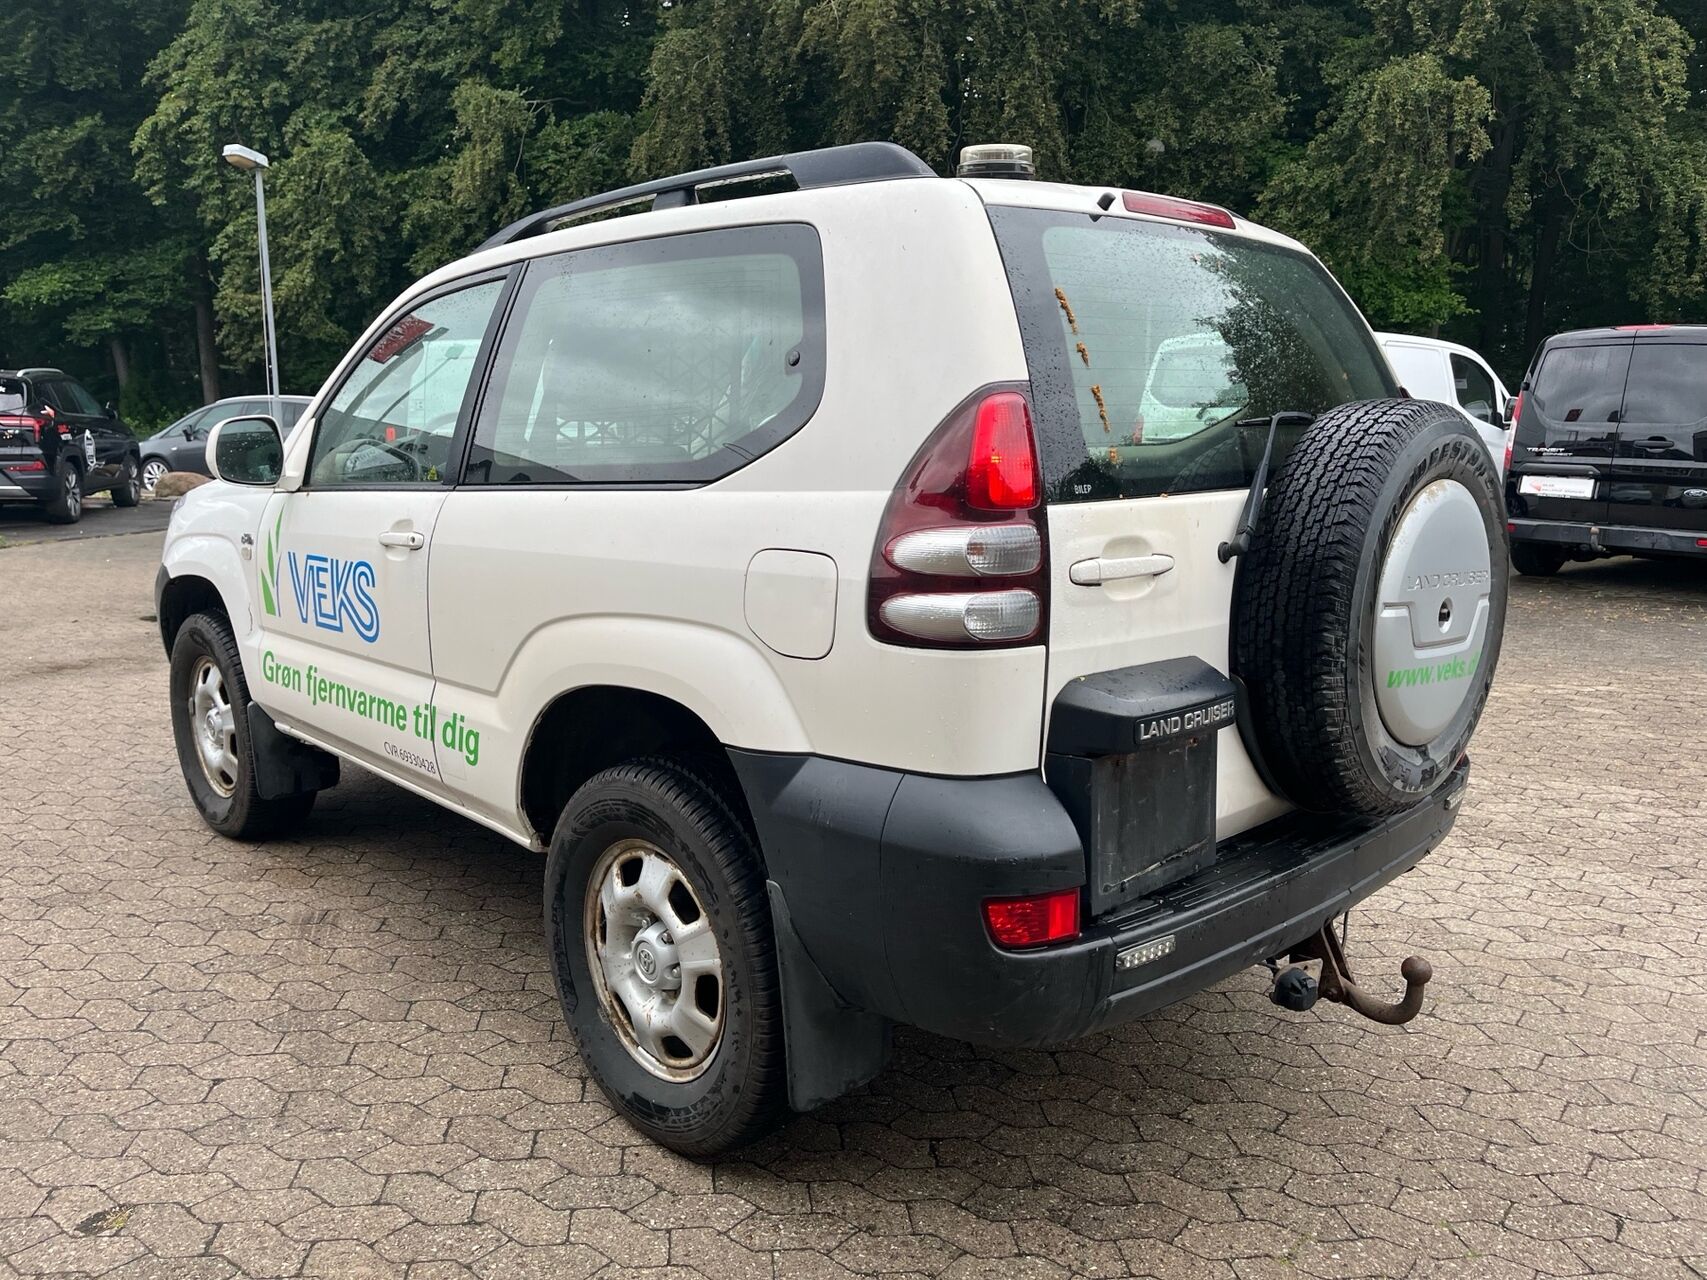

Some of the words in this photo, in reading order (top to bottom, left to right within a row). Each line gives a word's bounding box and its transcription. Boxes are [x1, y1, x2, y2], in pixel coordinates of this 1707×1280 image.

[287, 551, 380, 643] VEKS
[1407, 574, 1440, 591] LAND
[1442, 569, 1488, 587] CRUISER
[262, 650, 301, 693] Grøn
[306, 664, 407, 733] fjernvarme
[412, 703, 437, 742] til
[442, 712, 480, 766] dig
[1140, 716, 1181, 740] LAND
[1184, 699, 1236, 730] CRUISER
[383, 741, 399, 758] CVR
